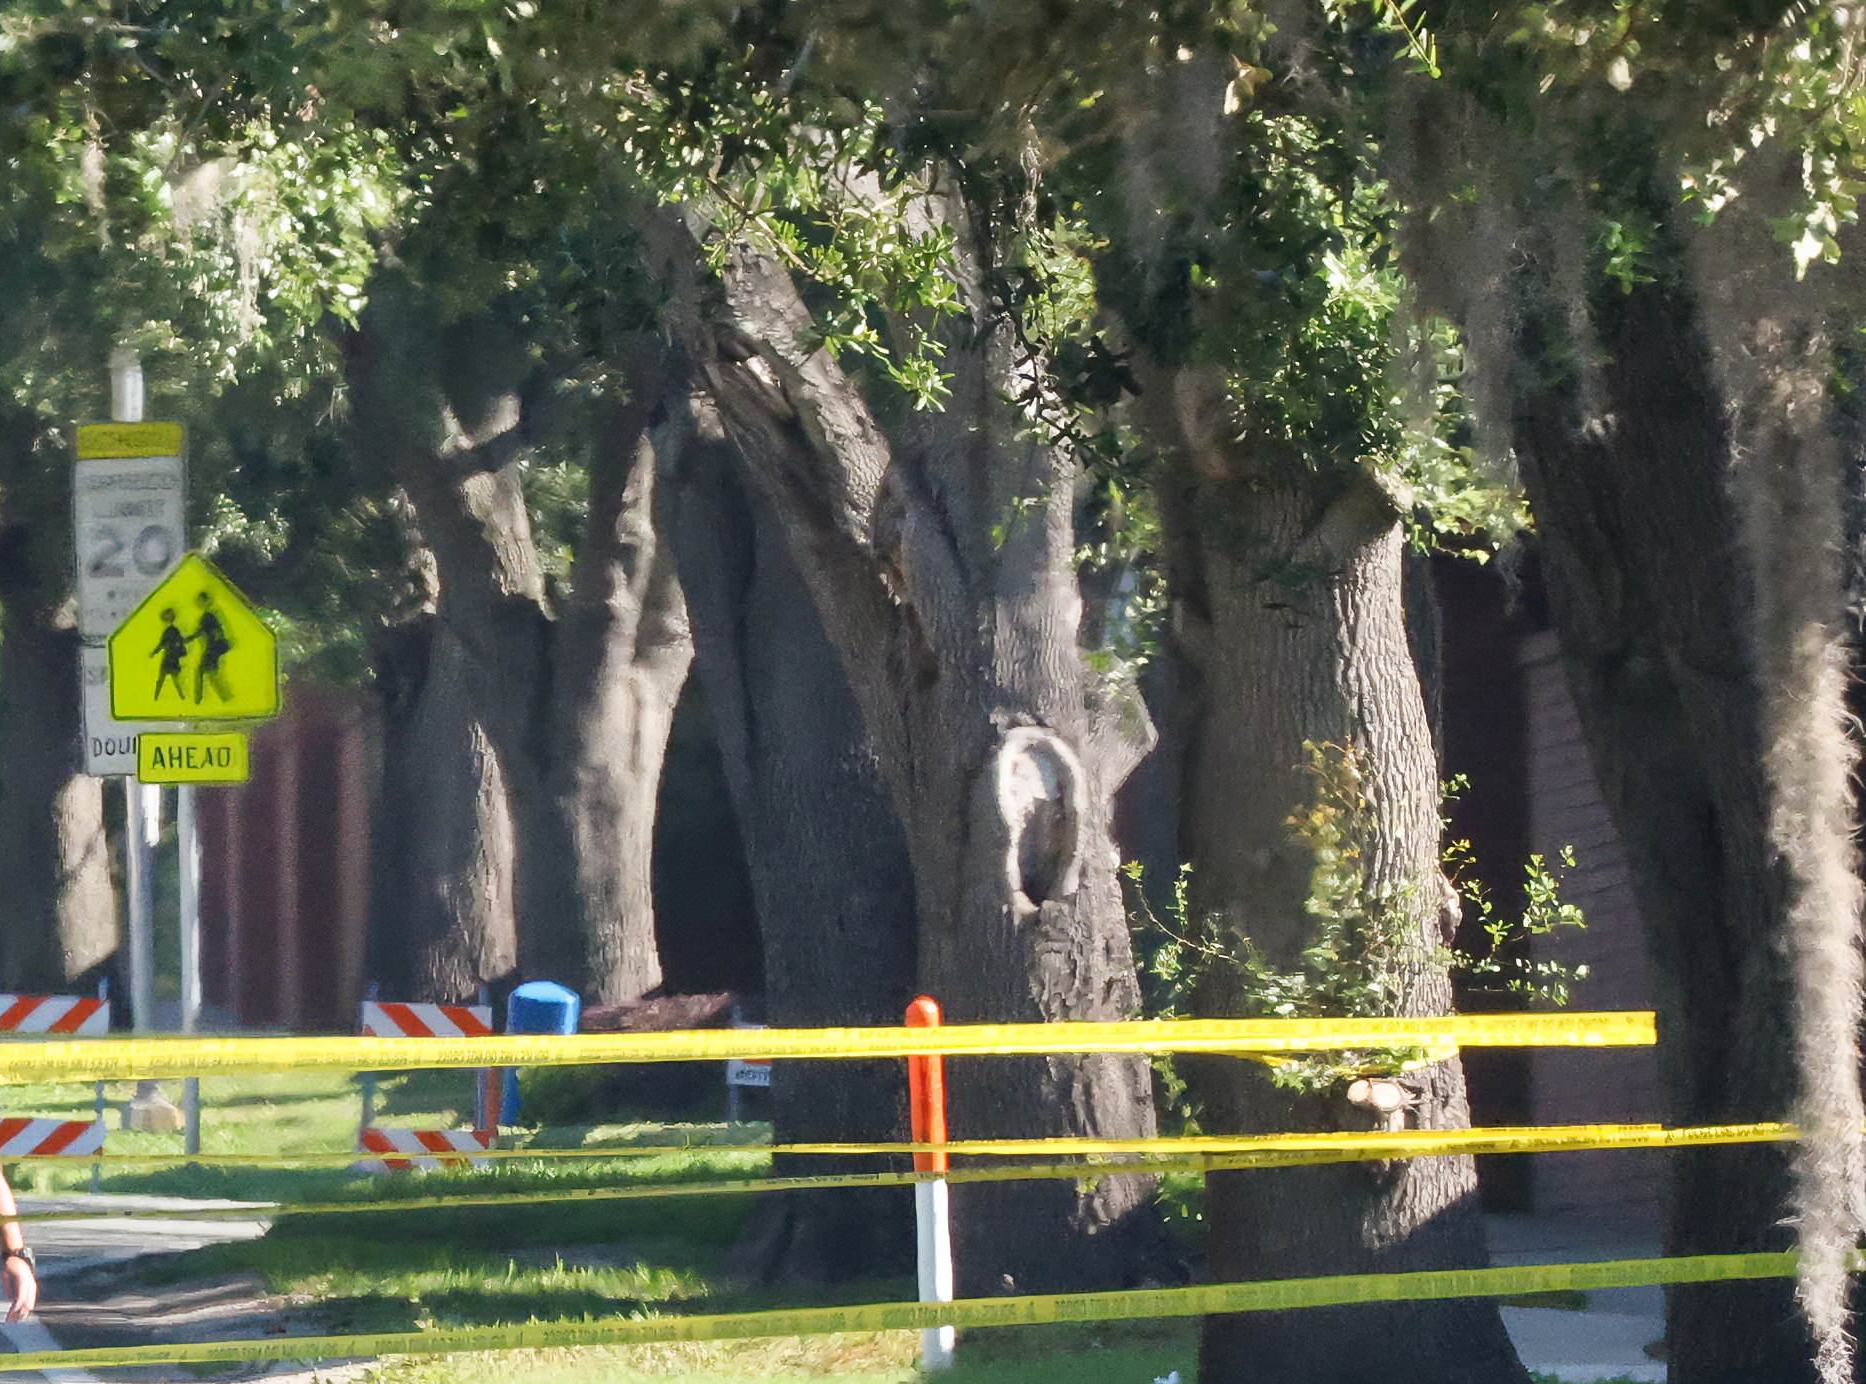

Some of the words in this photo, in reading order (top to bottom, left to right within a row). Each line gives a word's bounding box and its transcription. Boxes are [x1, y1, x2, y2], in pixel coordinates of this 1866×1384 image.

[87, 523, 173, 577] 20
[91, 736, 137, 757] DOU
[152, 745, 232, 770] AHEAD
